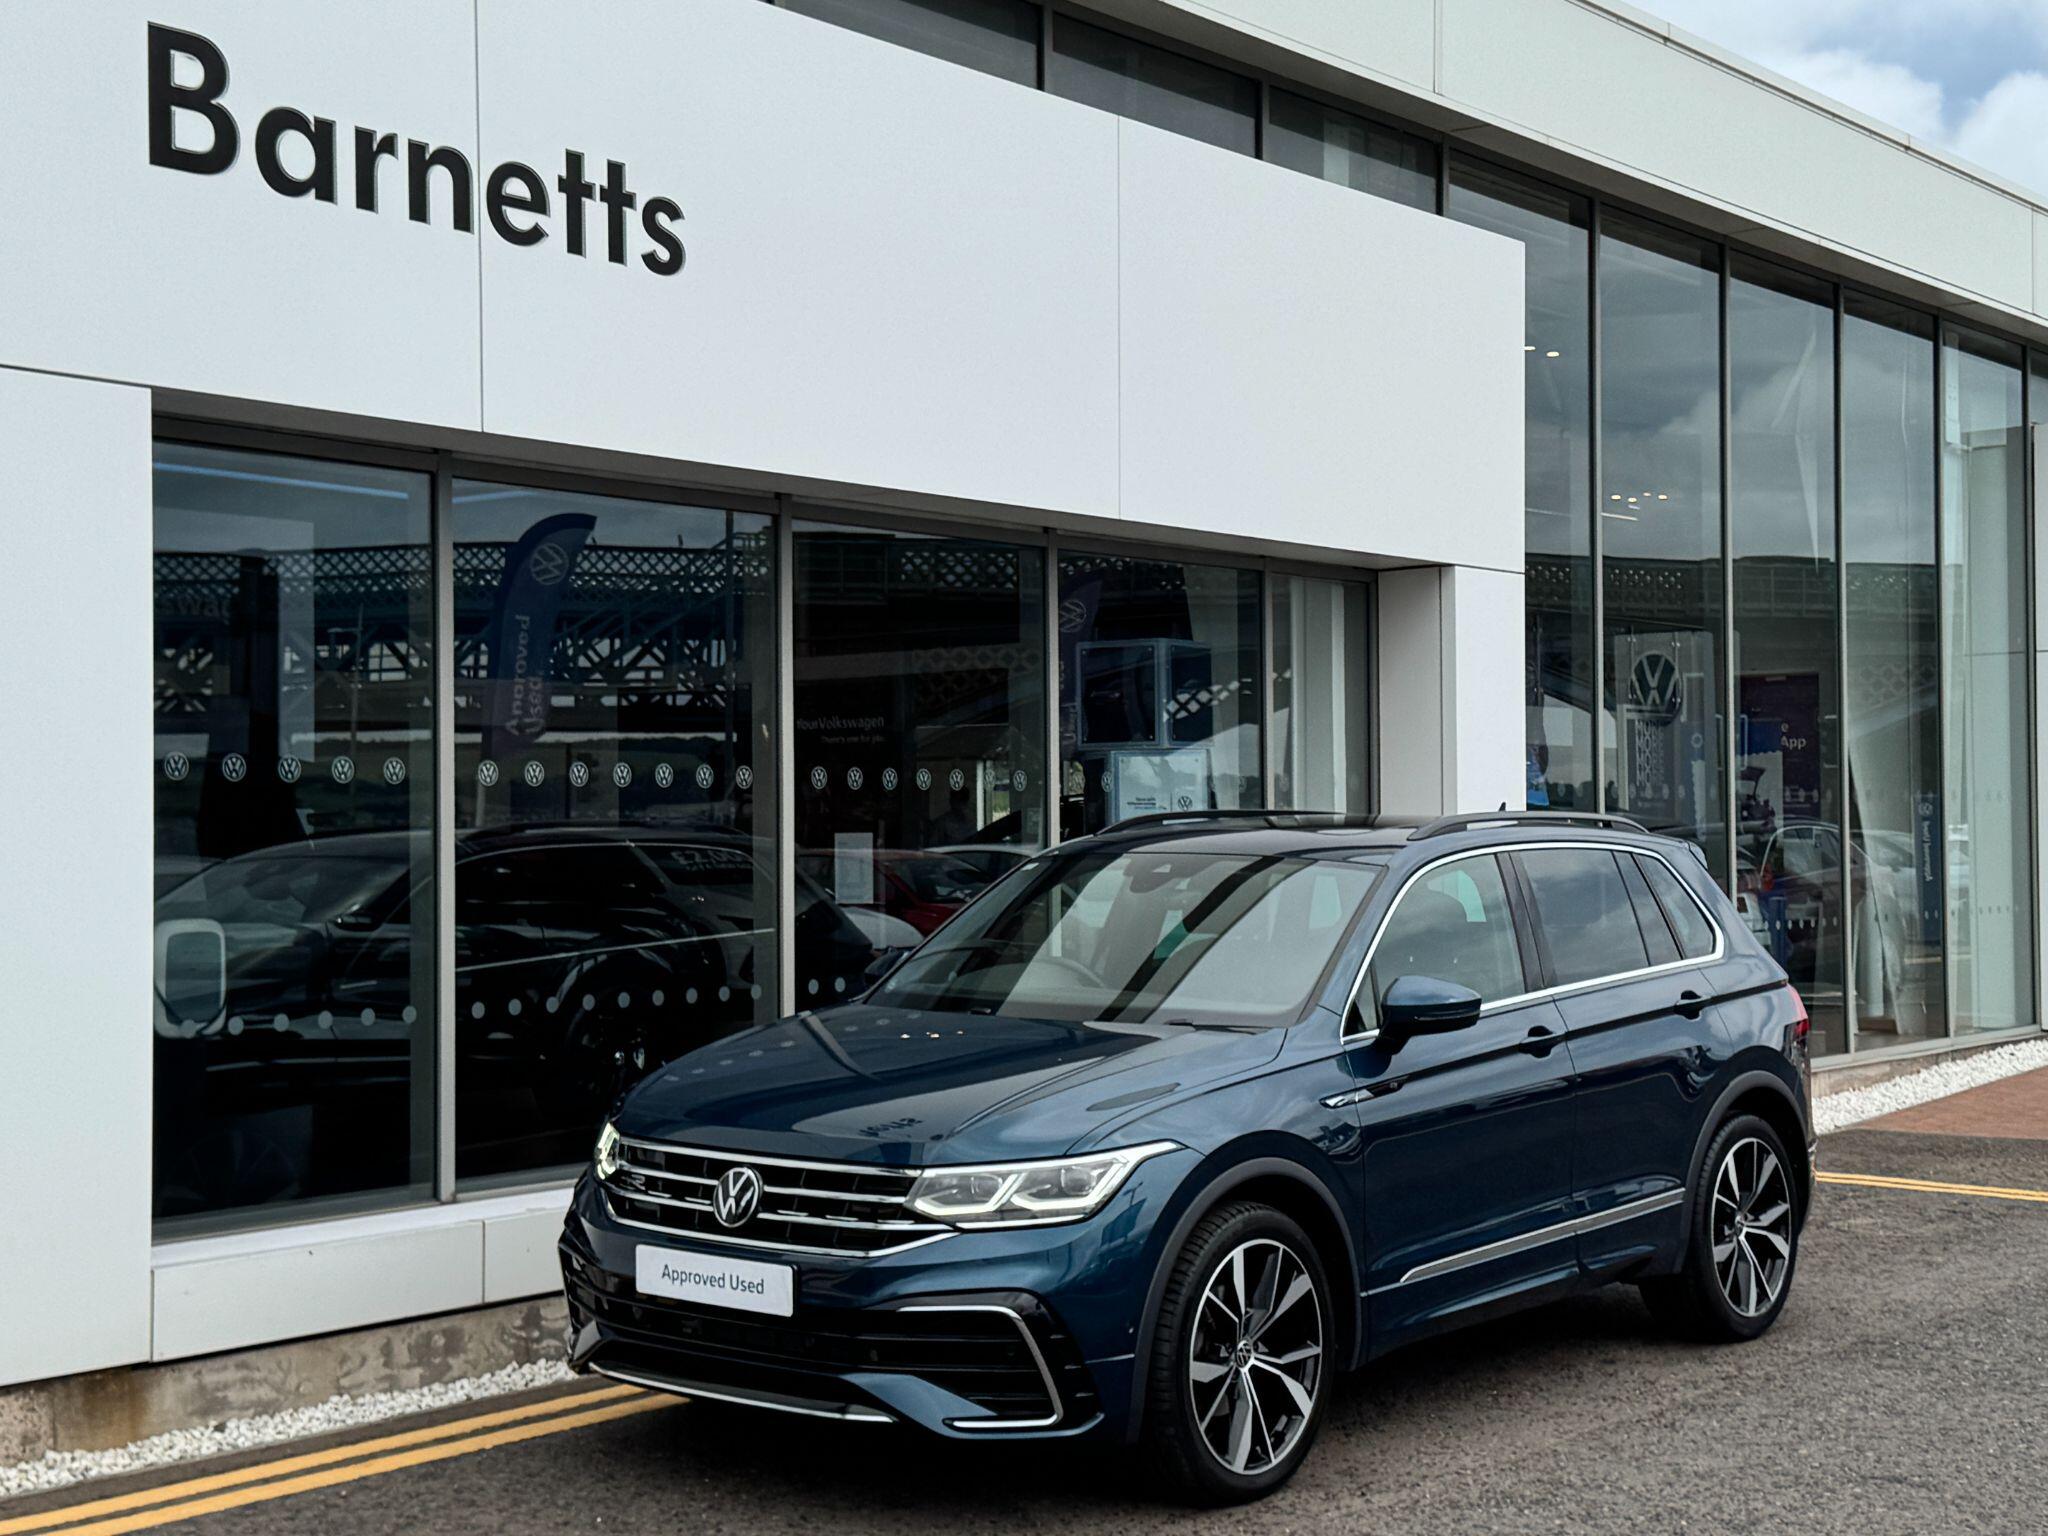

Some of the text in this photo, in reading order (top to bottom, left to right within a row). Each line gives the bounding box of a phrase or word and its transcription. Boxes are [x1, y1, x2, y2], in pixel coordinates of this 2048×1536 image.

[147, 20, 686, 276] Barnetts
[1780, 735, 1807, 750] App
[661, 1263, 765, 1295] Approved Used
